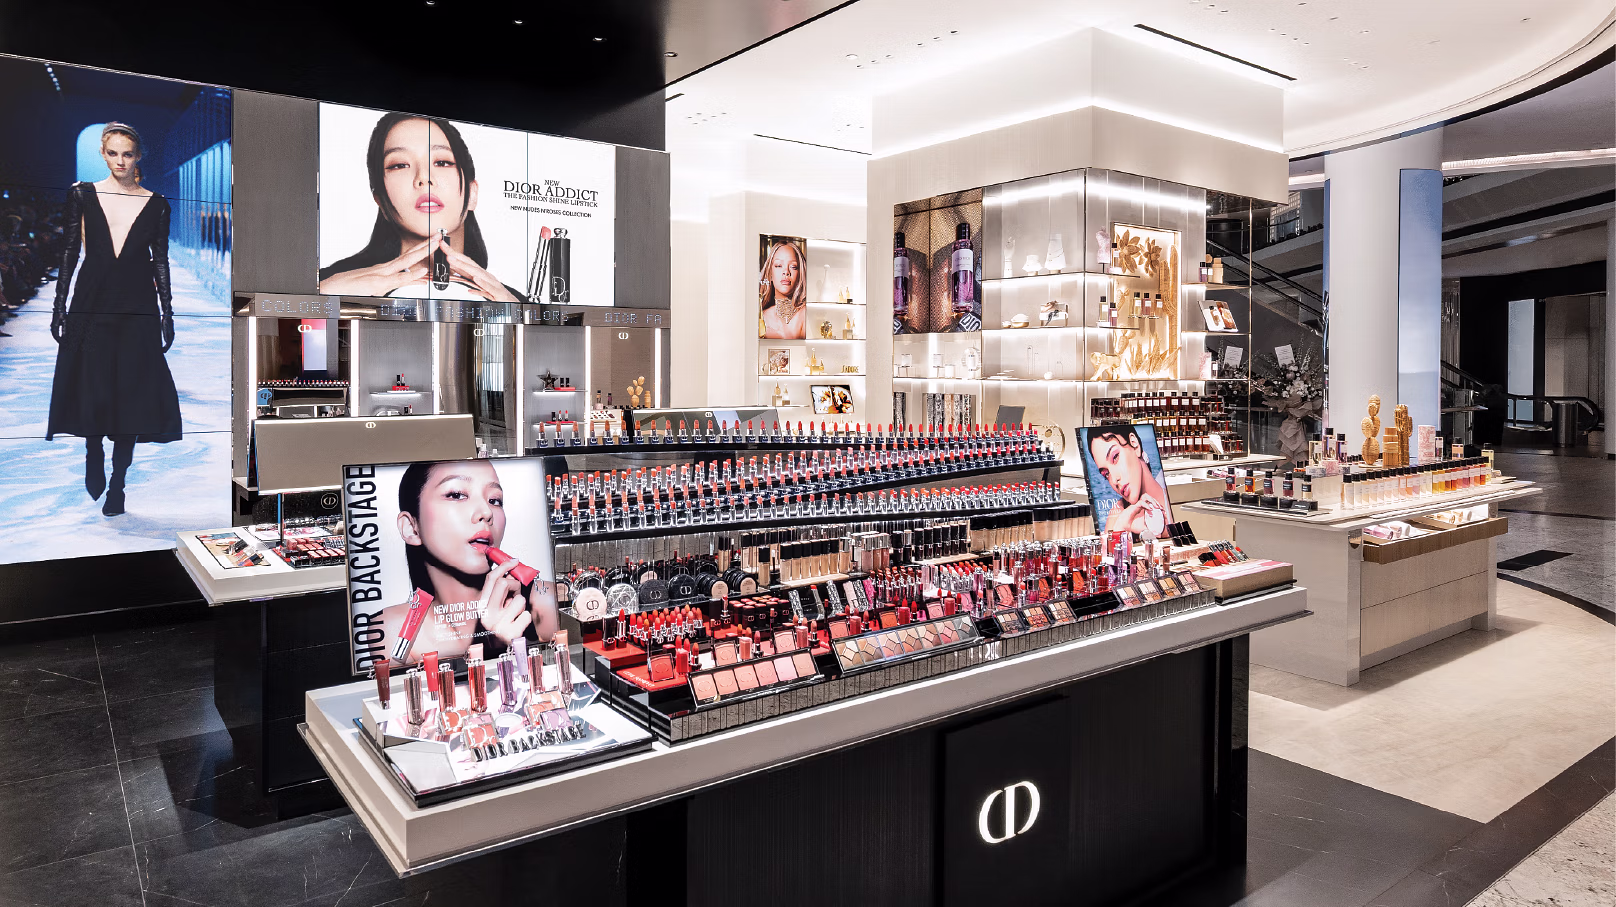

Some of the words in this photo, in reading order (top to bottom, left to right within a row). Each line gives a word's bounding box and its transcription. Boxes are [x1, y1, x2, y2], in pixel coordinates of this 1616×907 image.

[503, 180, 542, 196] DIOR
[545, 185, 599, 202] ADDICT
[503, 192, 518, 200] THE
[518, 194, 549, 203] FASHION
[549, 197, 570, 206] SHINE
[570, 199, 598, 209] LIPSTICK
[262, 299, 333, 315] COLORS
[604, 312, 638, 324] DIOR
[646, 313, 663, 325] FA
[1097, 498, 1121, 510] DIOR
[345, 464, 383, 604] BACKSTAGE
[433, 604, 449, 615] NEW
[449, 602, 466, 613] DIOR
[434, 614, 445, 625] LIP
[445, 612, 465, 623] GLOW
[465, 609, 489, 620] BUTTER
[354, 607, 387, 672] DIOR
[470, 741, 509, 763] DIOR
[508, 723, 587, 754] BACKSTAGE
